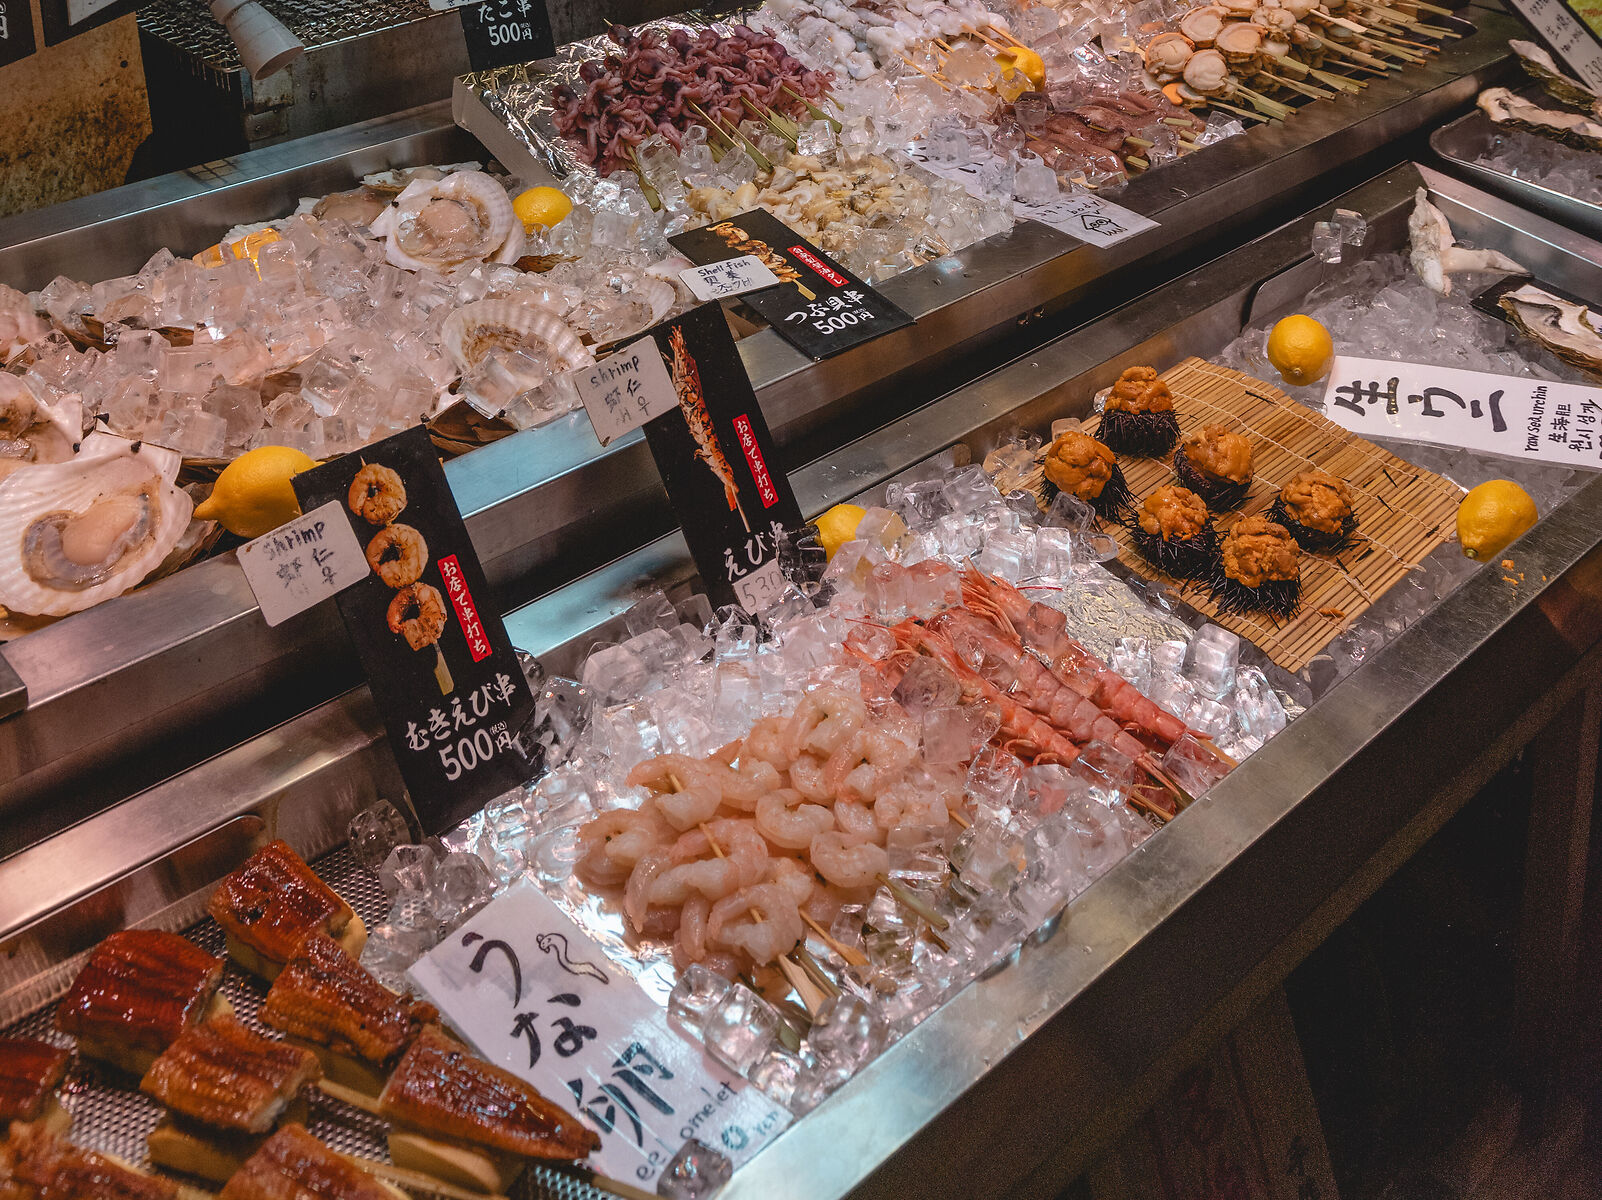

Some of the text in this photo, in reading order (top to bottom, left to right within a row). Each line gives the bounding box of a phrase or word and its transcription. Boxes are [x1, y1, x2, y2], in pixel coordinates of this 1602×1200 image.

[698, 259, 751, 278] Shell fish
[784, 290, 865, 326] つぶ貝串
[1532, 385, 1548, 411] urchin
[737, 420, 775, 502] お店で串打ち
[1525, 428, 1540, 452] raw
[443, 561, 487, 654] お店で串打ち
[405, 672, 517, 752] むきえび串
[680, 1080, 738, 1140] omelet
